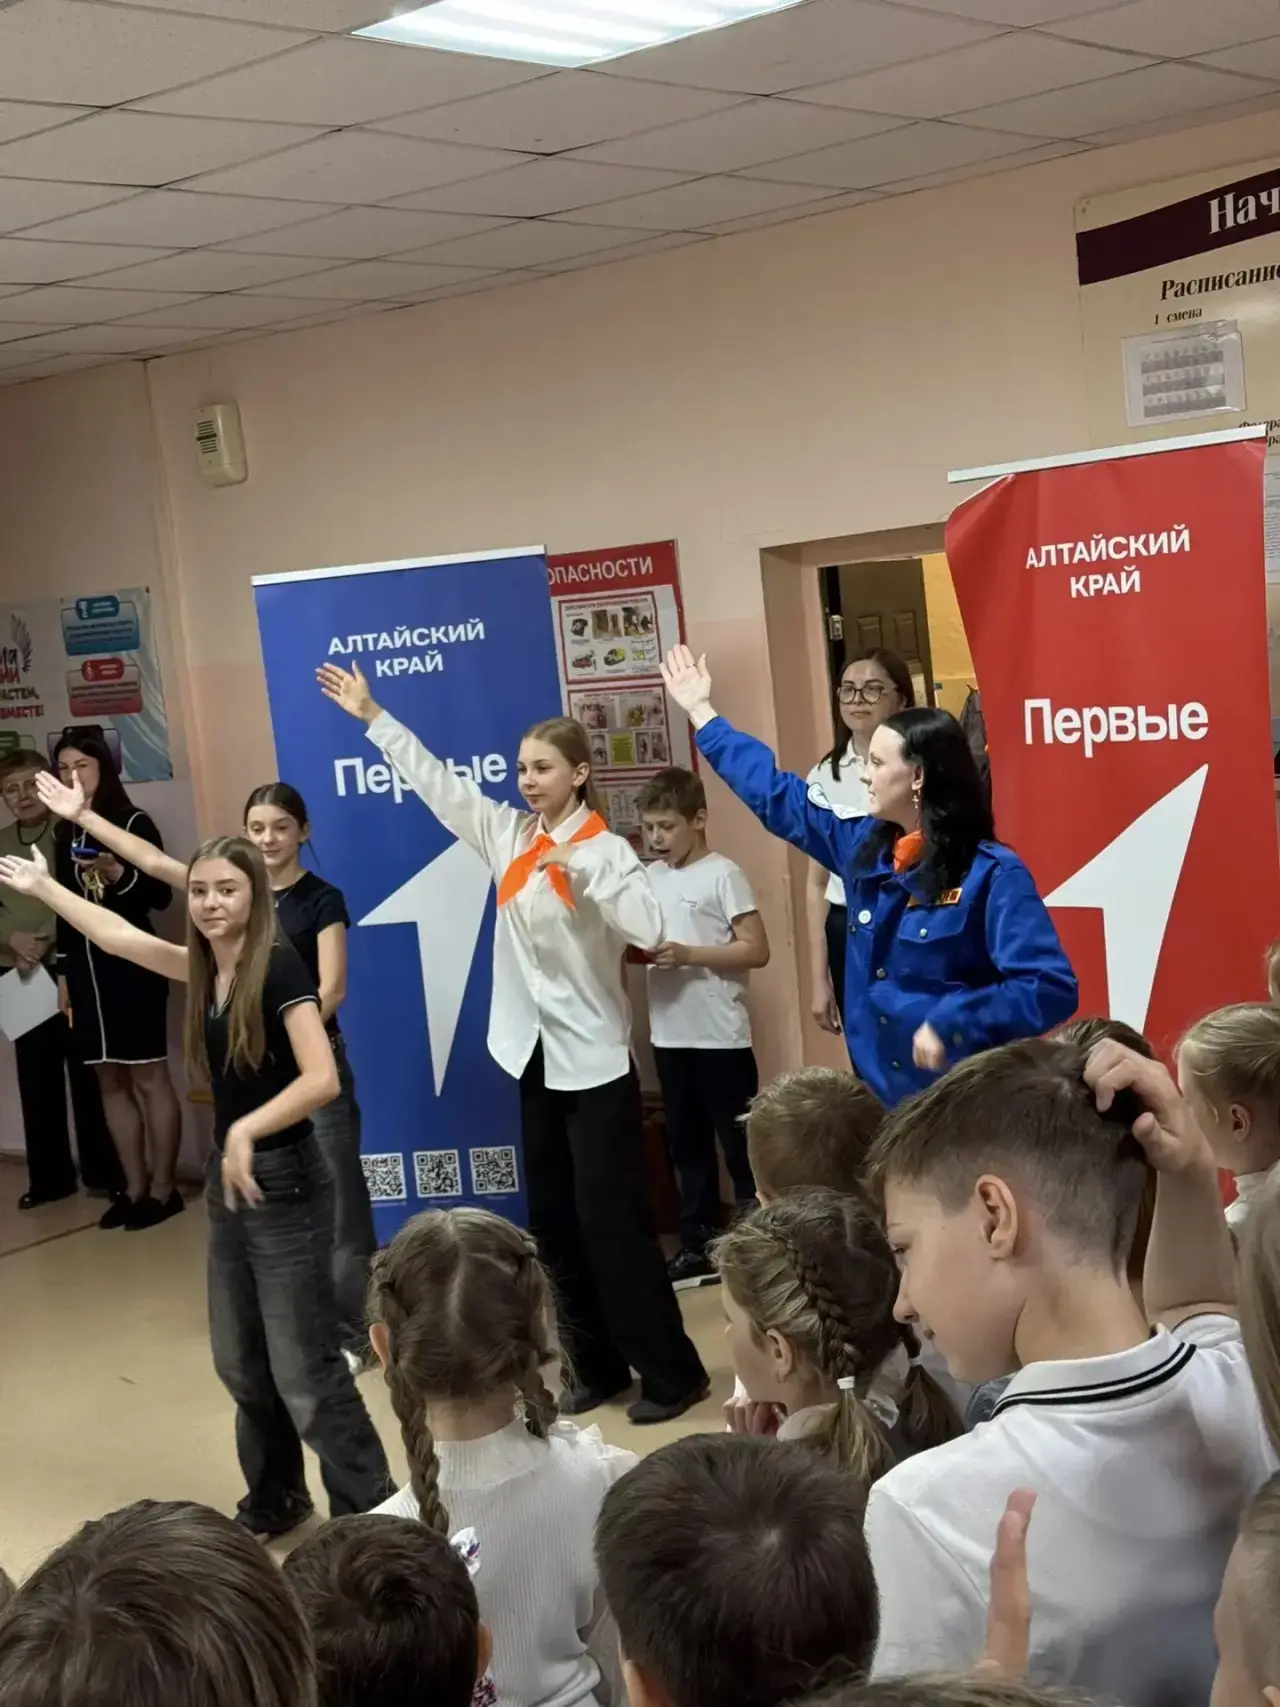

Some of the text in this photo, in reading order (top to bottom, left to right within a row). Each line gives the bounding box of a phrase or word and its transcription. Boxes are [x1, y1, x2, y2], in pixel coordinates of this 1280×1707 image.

[1208, 187, 1280, 235] Нач
[1167, 308, 1202, 323] смена
[1025, 524, 1190, 569] АЛТАЙСКИЙ
[1070, 565, 1141, 598] КРАЙ
[328, 618, 485, 655] АЛТАЙСКИЙ
[375, 650, 444, 677] КРАЙ
[1024, 698, 1209, 758] Первые
[334, 753, 507, 804] Перые
